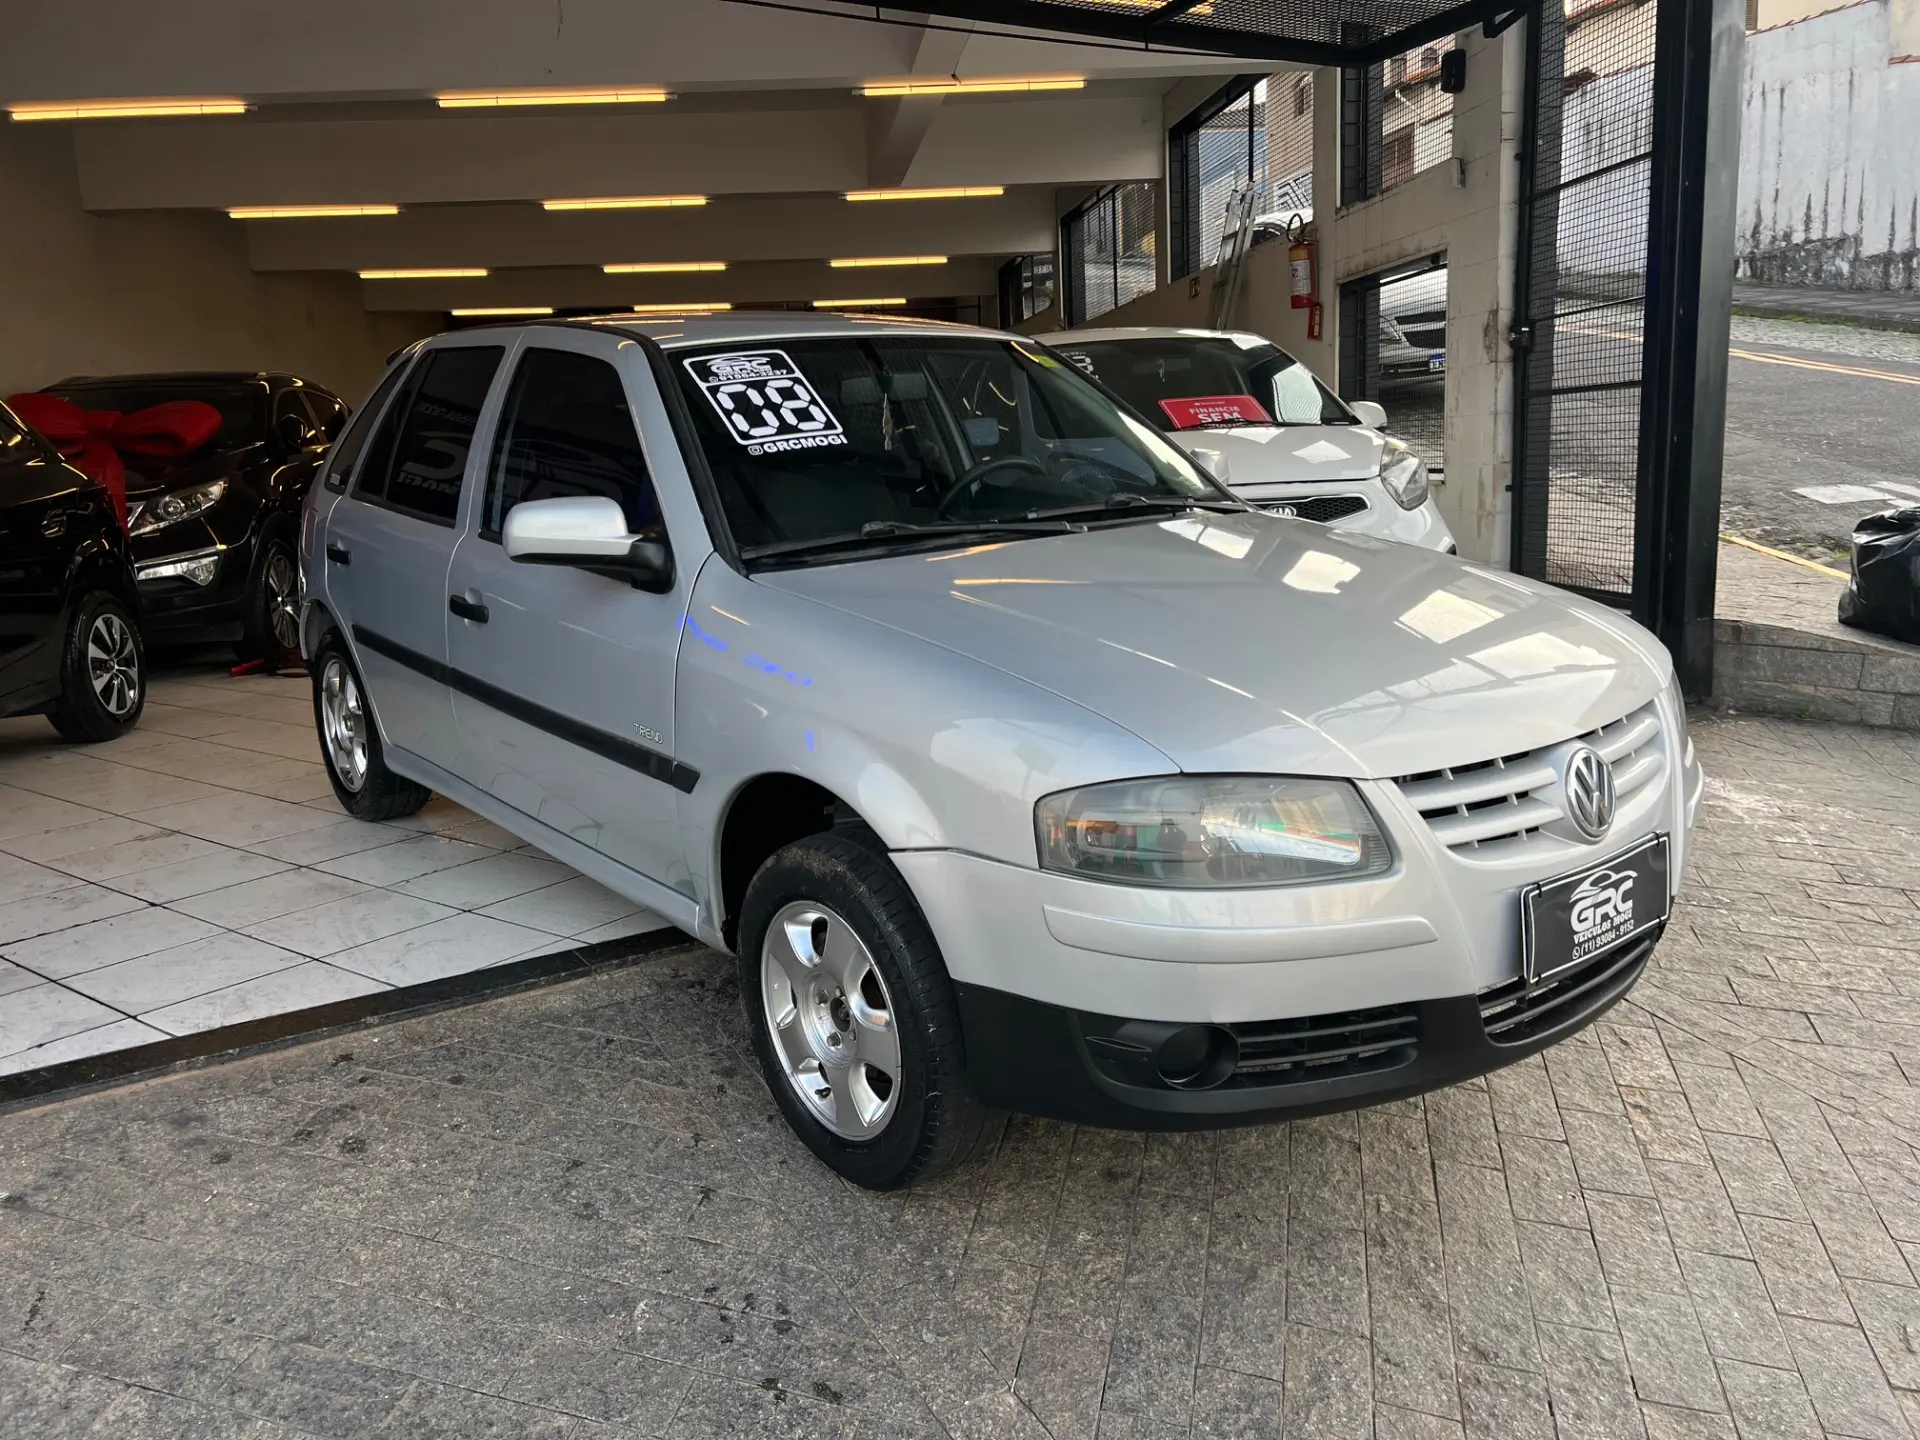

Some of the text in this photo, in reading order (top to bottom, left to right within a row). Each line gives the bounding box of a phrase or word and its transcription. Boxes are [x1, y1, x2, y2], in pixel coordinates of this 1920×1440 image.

[716, 379, 827, 437] 08
[633, 722, 664, 744] TREND
[1570, 878, 1633, 932] GRC
[1573, 919, 1611, 944] VEICULOS
[1580, 939, 1595, 956] (11)
